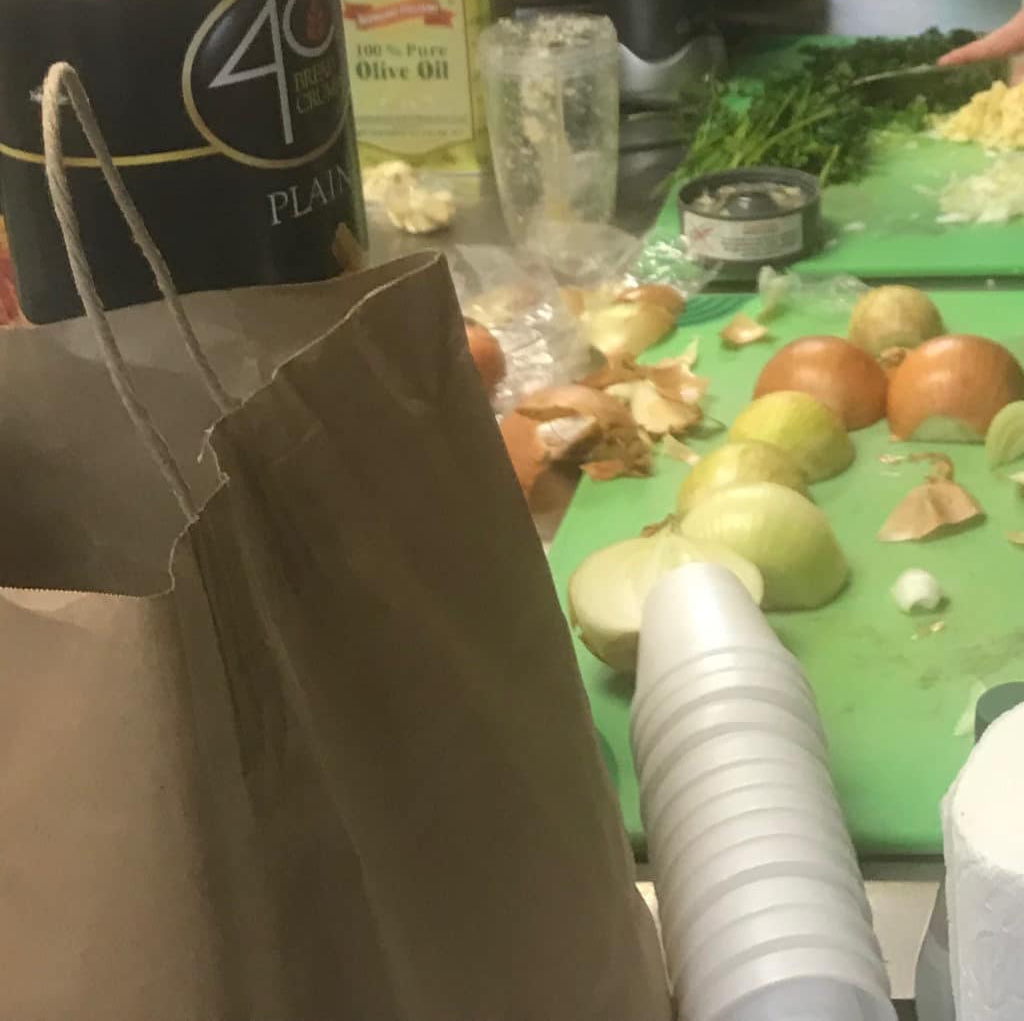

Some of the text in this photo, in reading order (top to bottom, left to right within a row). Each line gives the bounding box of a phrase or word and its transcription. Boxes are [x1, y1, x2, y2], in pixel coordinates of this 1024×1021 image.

[355, 59, 449, 81] Olive Oil
[267, 163, 352, 227] PLAIN
